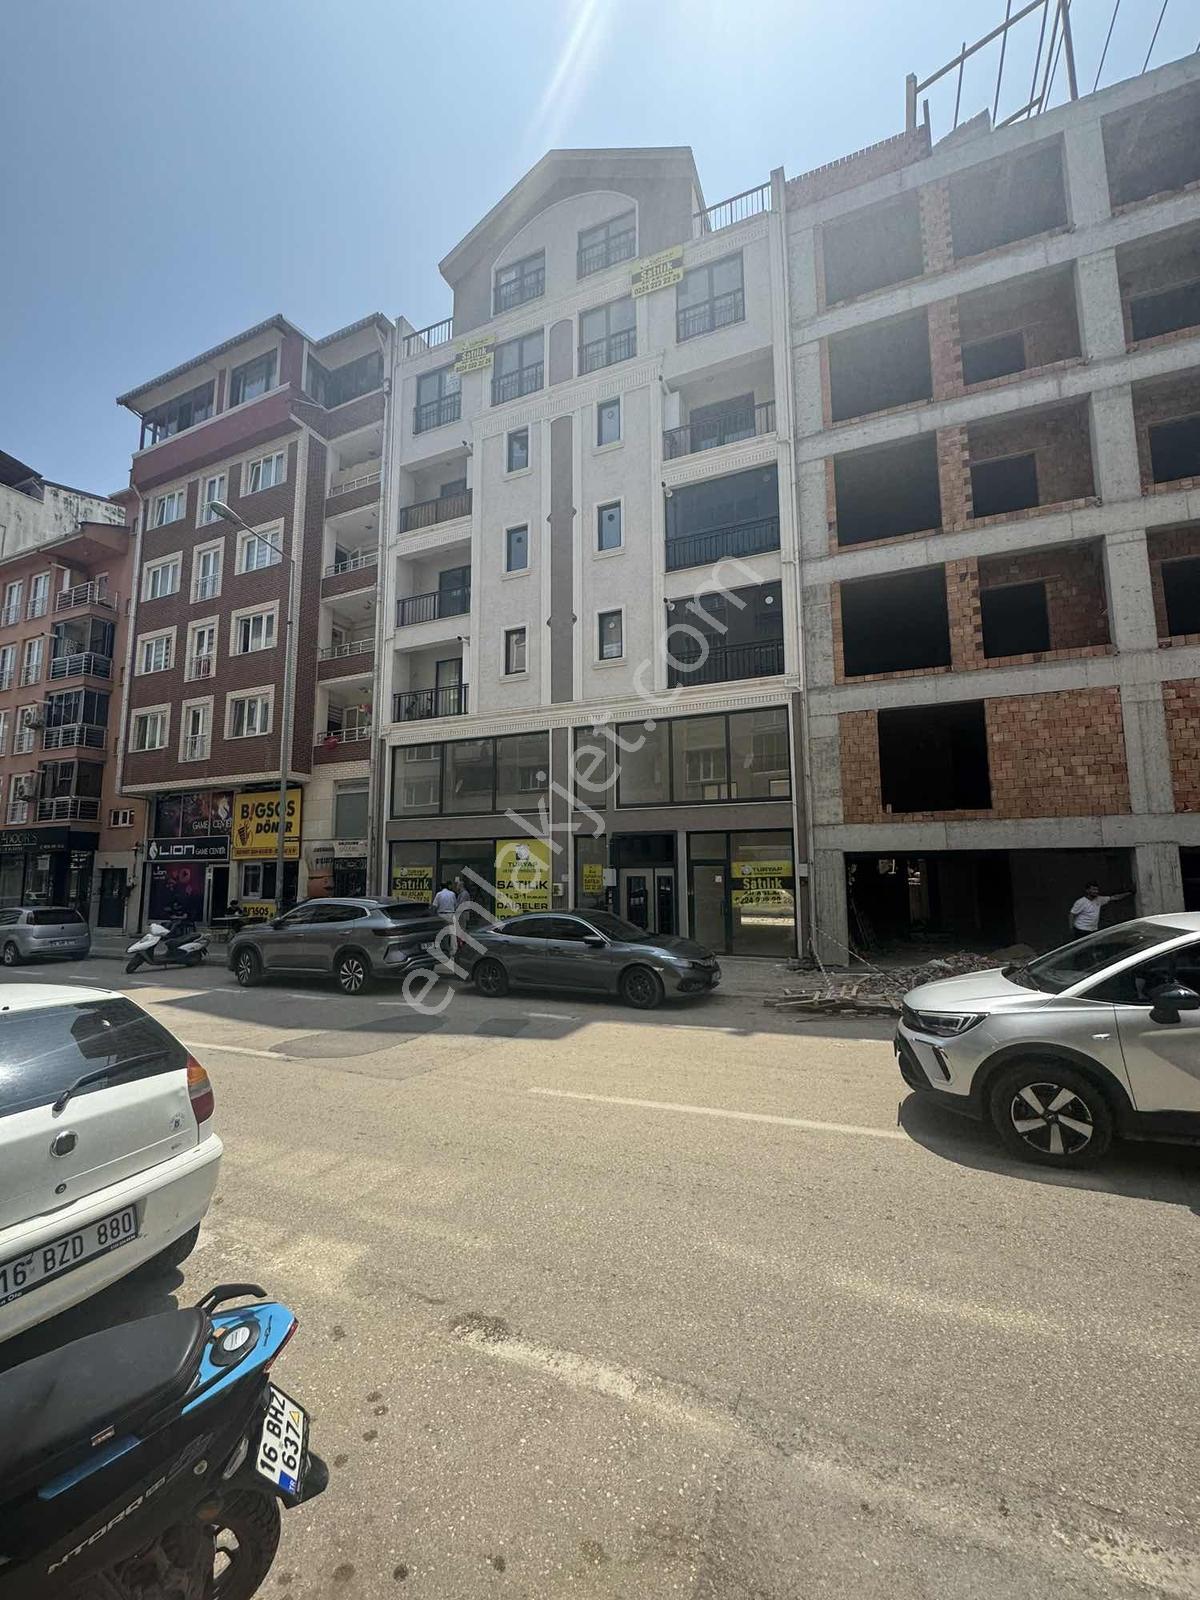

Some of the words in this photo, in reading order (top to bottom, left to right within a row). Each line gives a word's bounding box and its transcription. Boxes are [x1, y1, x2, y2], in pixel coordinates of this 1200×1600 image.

[255, 820, 293, 834] DÖNR
[395, 878, 429, 890] Satılık
[743, 877, 783, 890] Satılık
[0, 1262, 26, 1293] 16
[43, 1235, 83, 1273] BZD
[97, 1212, 132, 1245] 880
[266, 1391, 286, 1439] BHZ
[260, 1442, 278, 1473] 16
[282, 1420, 300, 1471] 637
